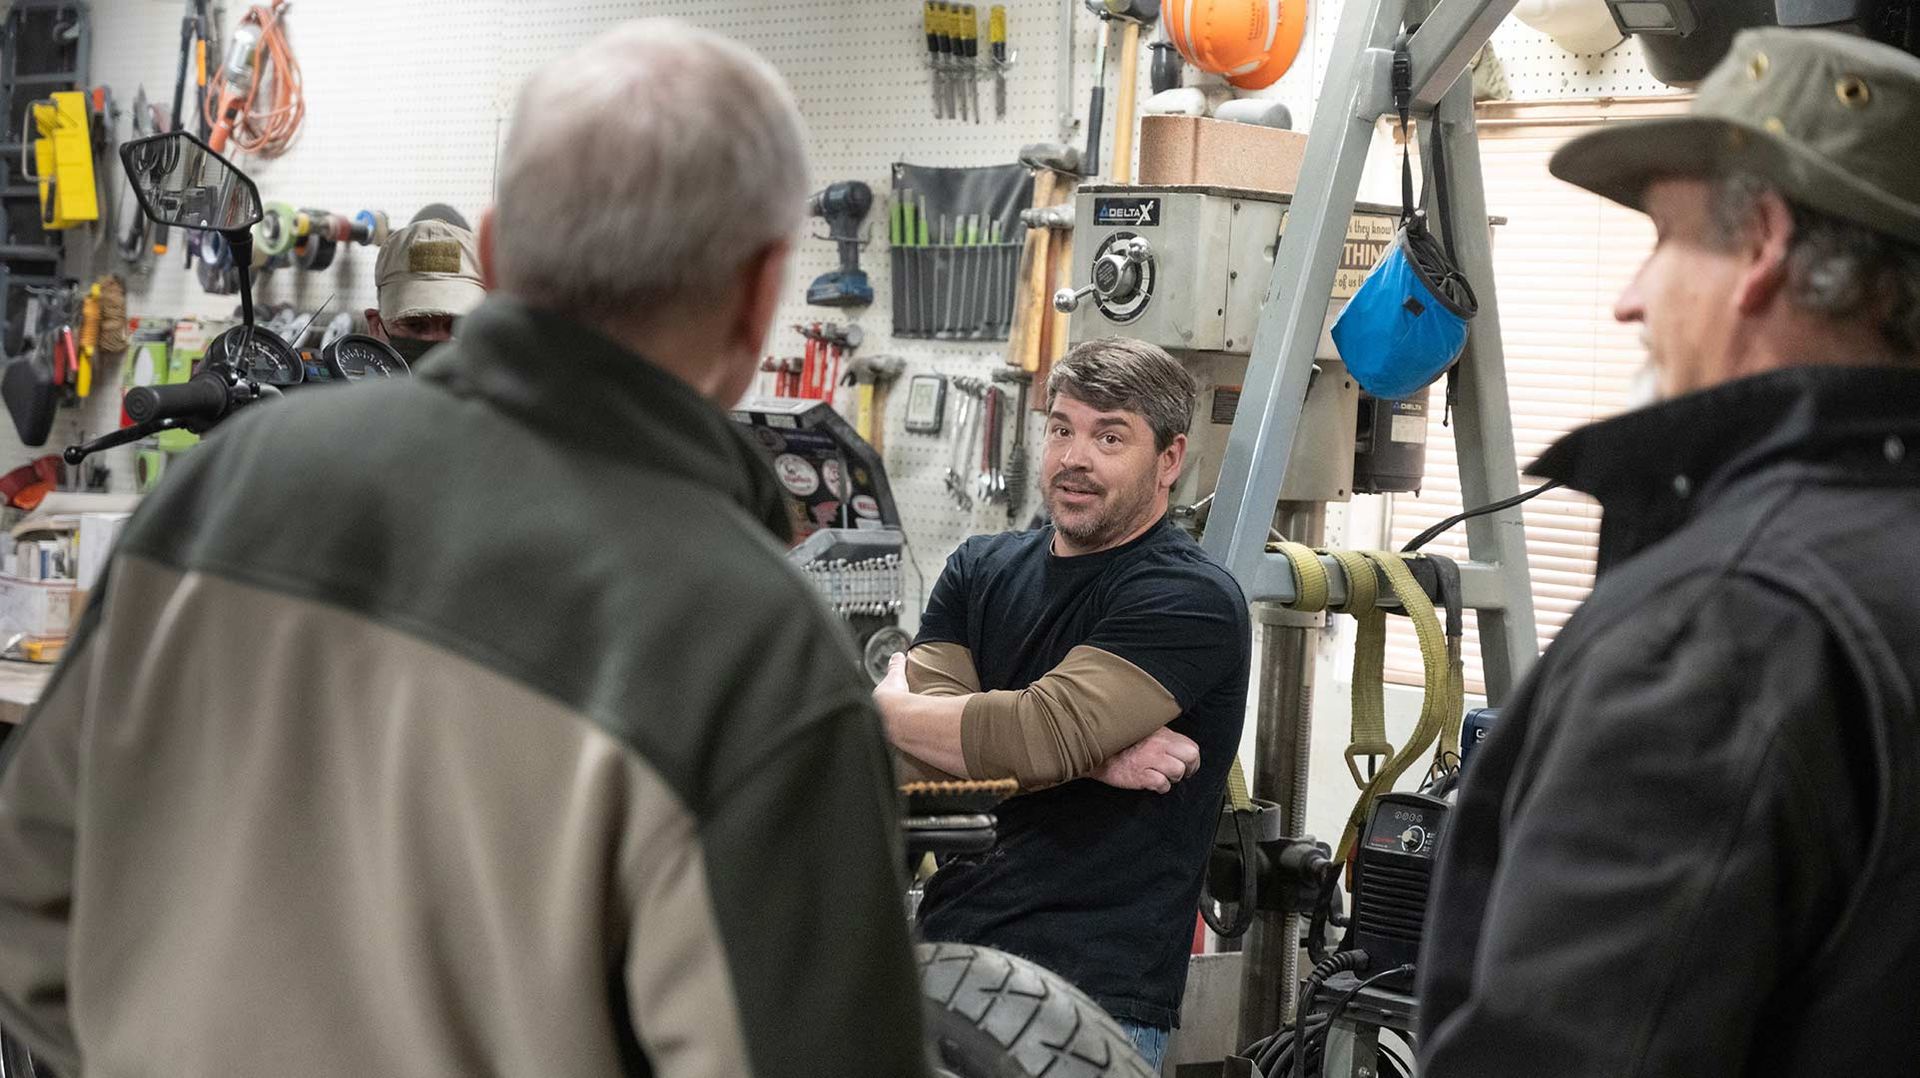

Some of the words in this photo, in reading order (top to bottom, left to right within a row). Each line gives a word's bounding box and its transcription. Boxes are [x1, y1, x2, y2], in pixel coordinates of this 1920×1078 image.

[1109, 208, 1140, 217] DELTA
[1355, 220, 1370, 239] they
[1372, 221, 1391, 234] know
